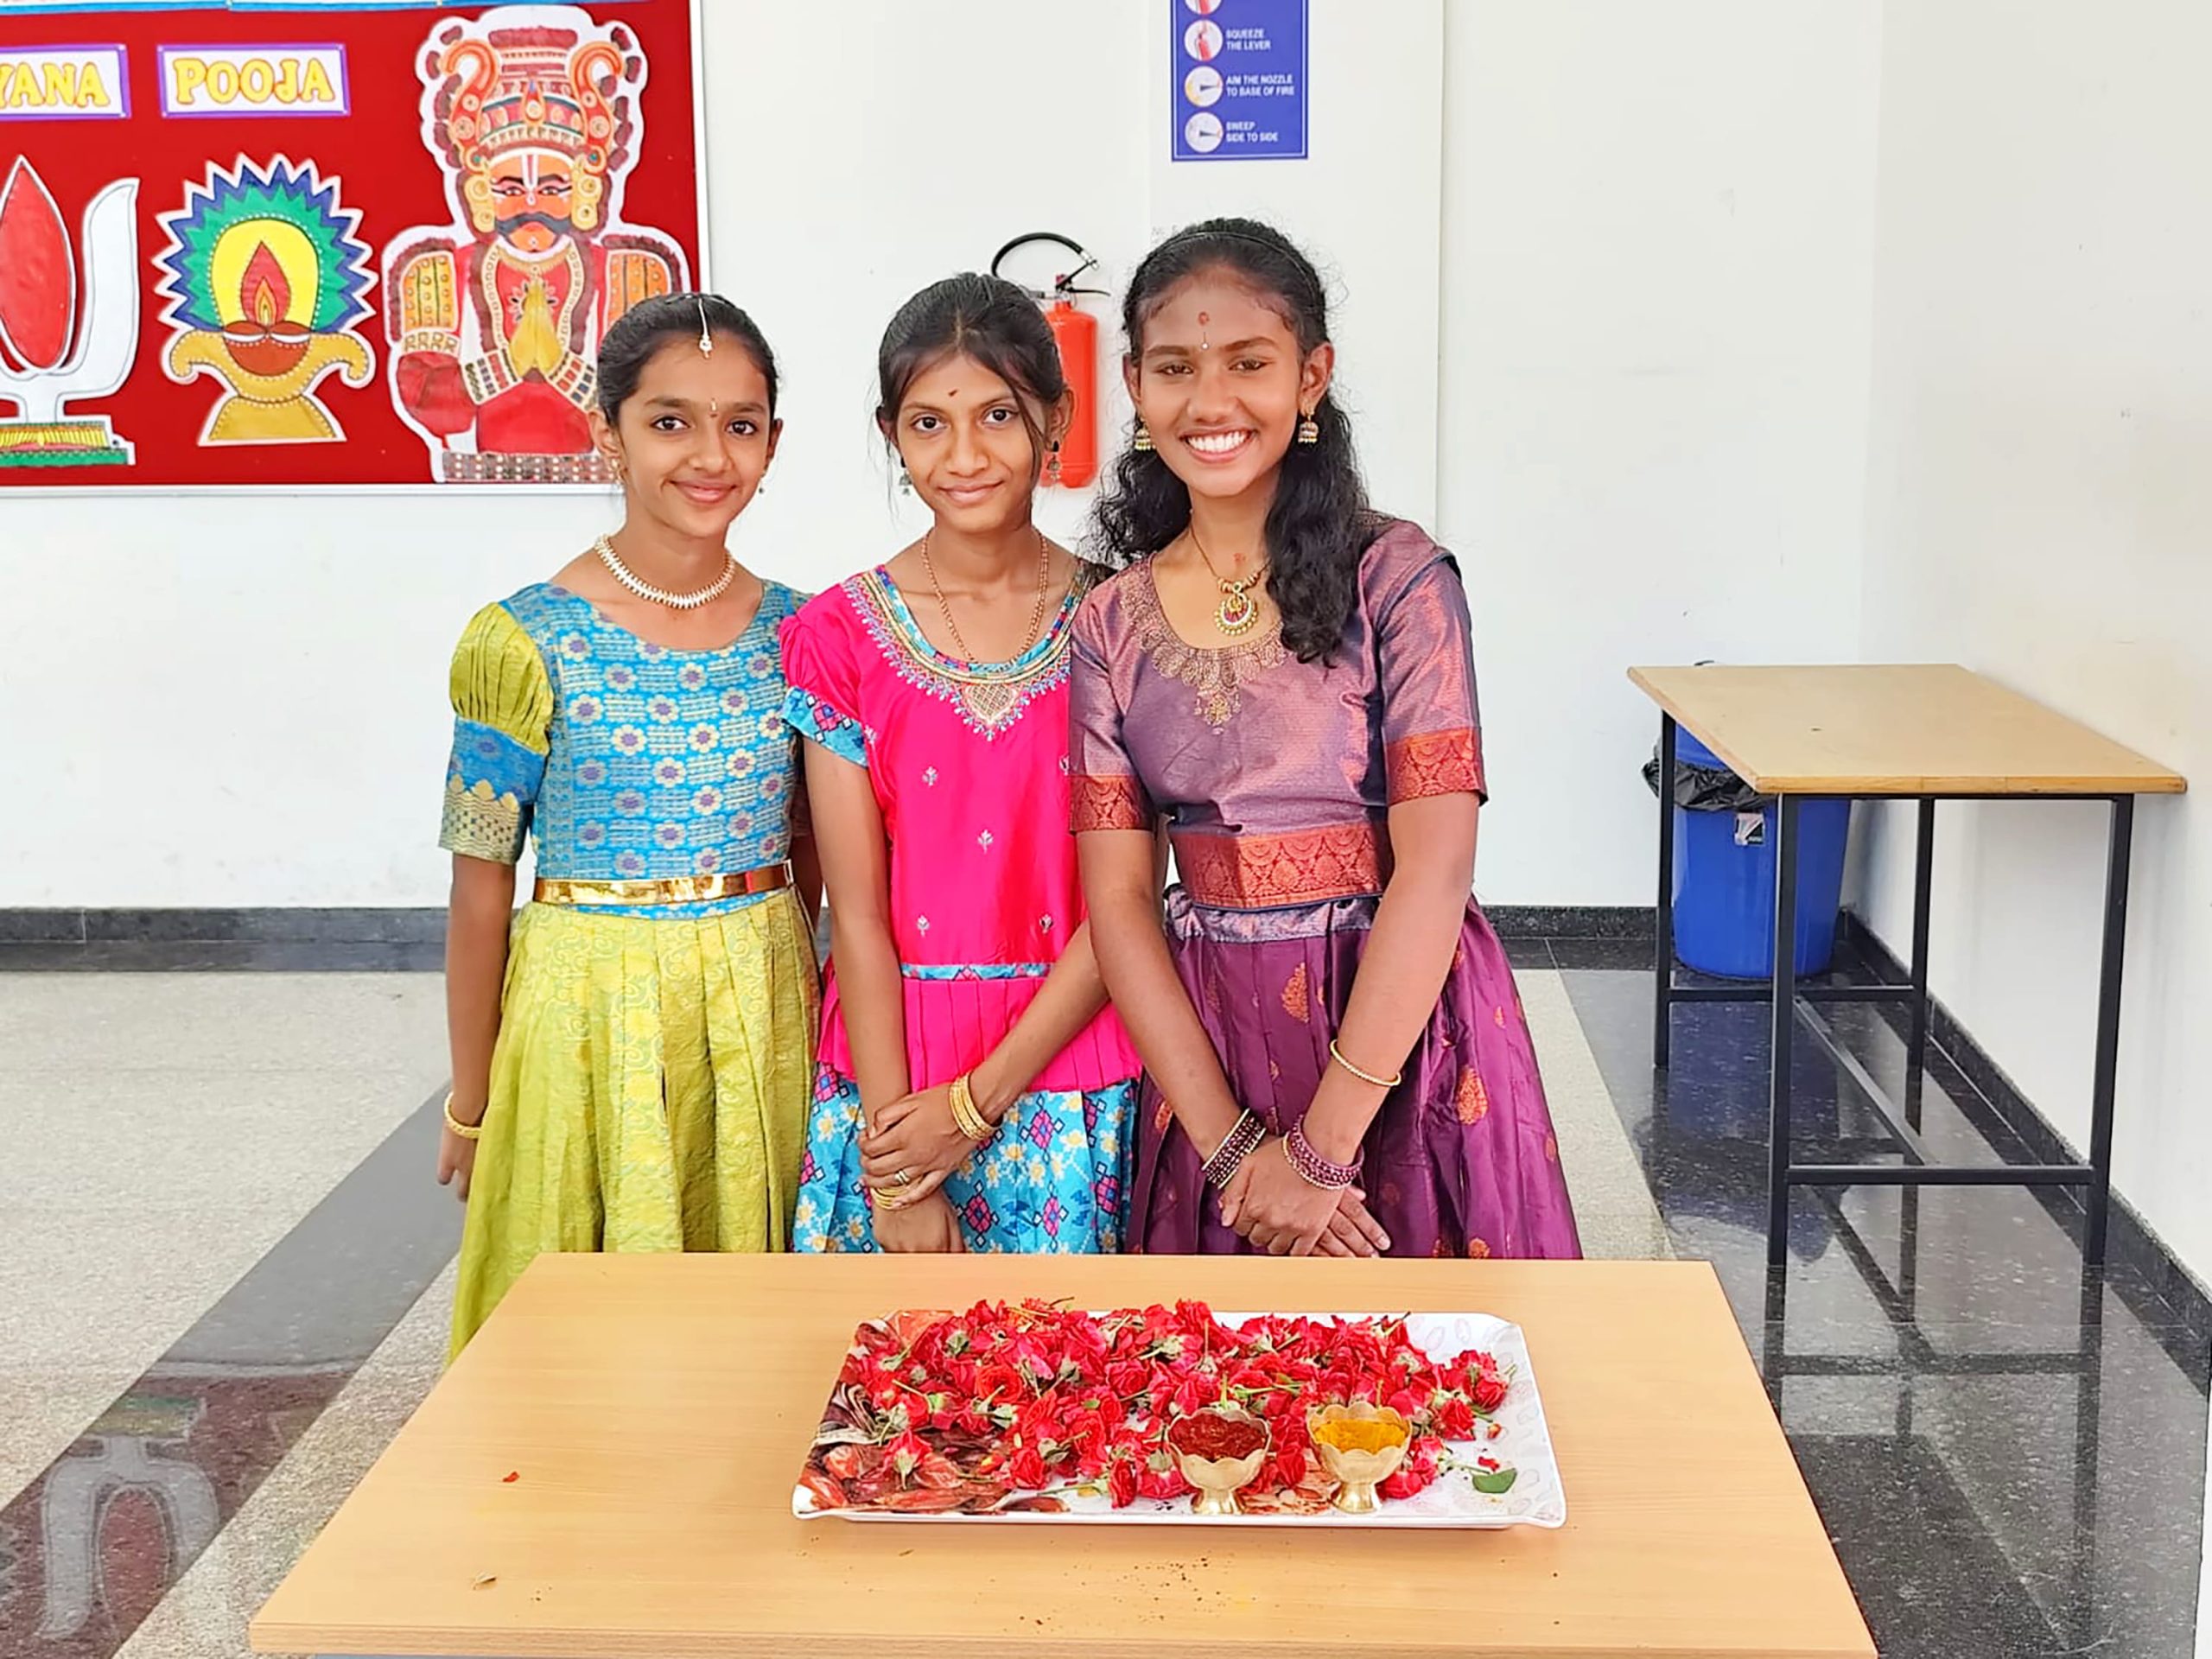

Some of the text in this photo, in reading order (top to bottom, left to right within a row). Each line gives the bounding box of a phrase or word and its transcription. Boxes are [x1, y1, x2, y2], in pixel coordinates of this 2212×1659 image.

[1226, 29, 1264, 39] SQUEEZE
[1227, 40, 1271, 50] THE LEVER
[173, 57, 336, 105] POOJA
[1243, 75, 1259, 85] THE
[1261, 74, 1293, 84] NOZZLE
[1227, 86, 1294, 96] TO BASE OF FIRE
[1247, 132, 1258, 142] TO
